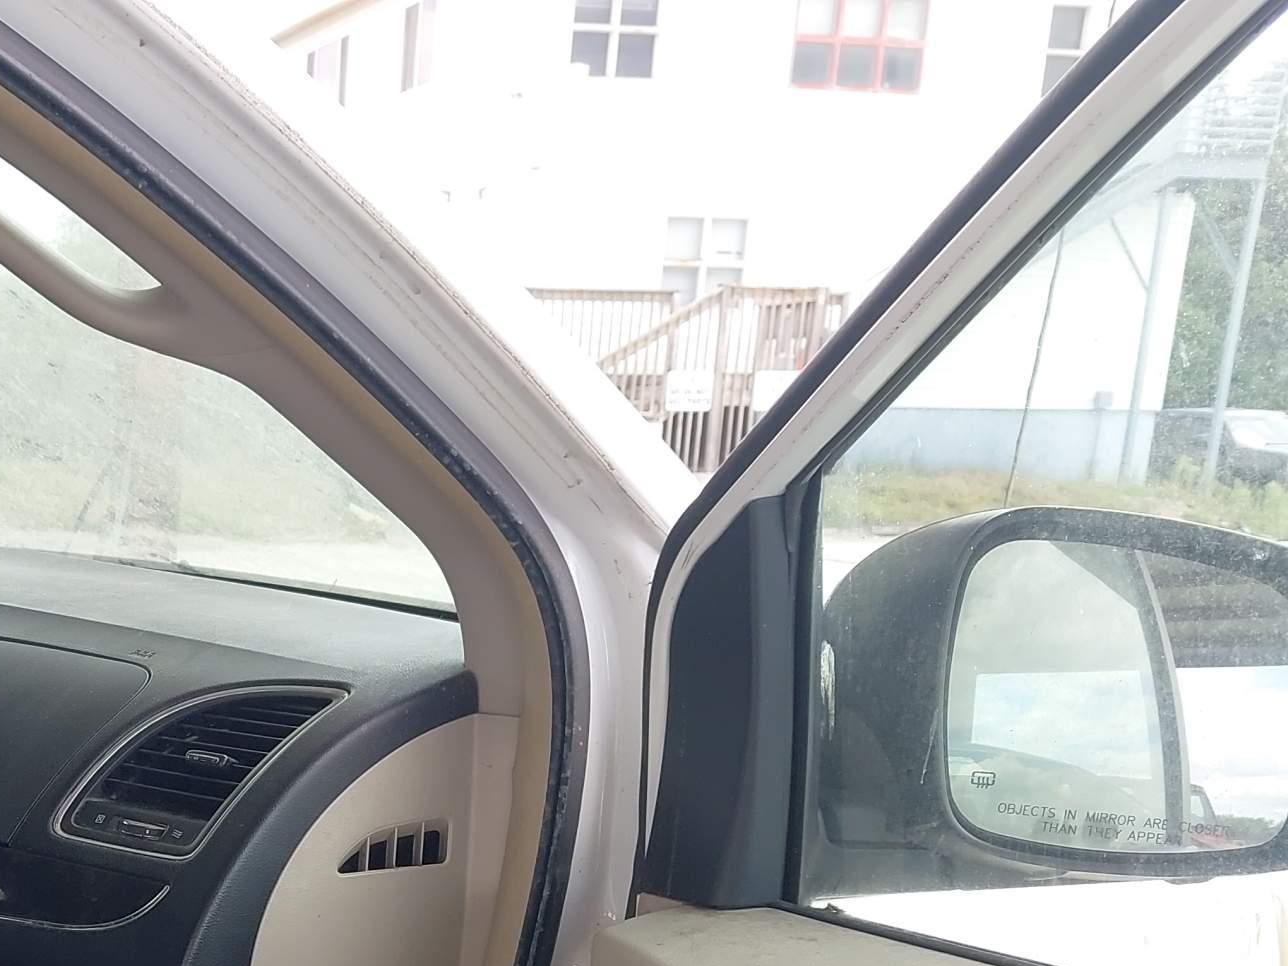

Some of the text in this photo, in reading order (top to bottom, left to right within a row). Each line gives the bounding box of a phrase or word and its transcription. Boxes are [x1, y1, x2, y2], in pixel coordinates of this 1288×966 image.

[997, 802, 1231, 838] OBJECTS IN MIRROR ARE CLOSER
[1041, 821, 1182, 846] THAN THEY APPEAR
